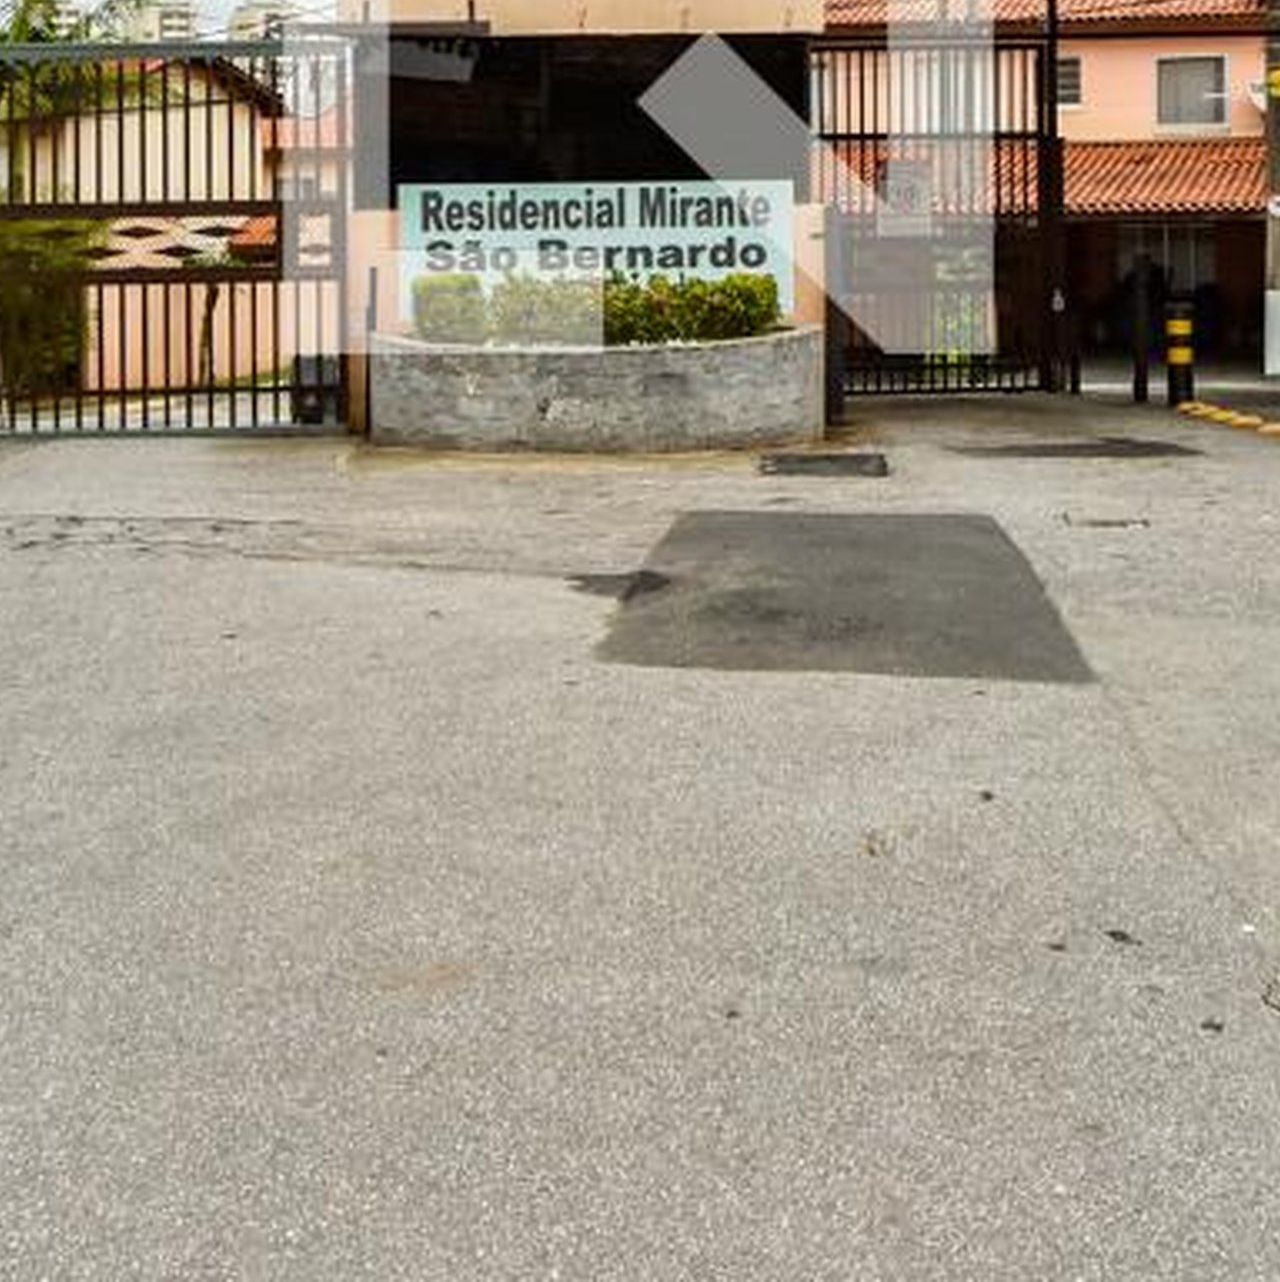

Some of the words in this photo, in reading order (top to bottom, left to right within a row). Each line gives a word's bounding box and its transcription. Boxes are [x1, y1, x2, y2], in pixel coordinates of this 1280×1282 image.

[421, 188, 625, 232] Residencial
[640, 187, 772, 230] Mirante
[426, 239, 516, 273] São
[538, 235, 767, 271] Bernardo
